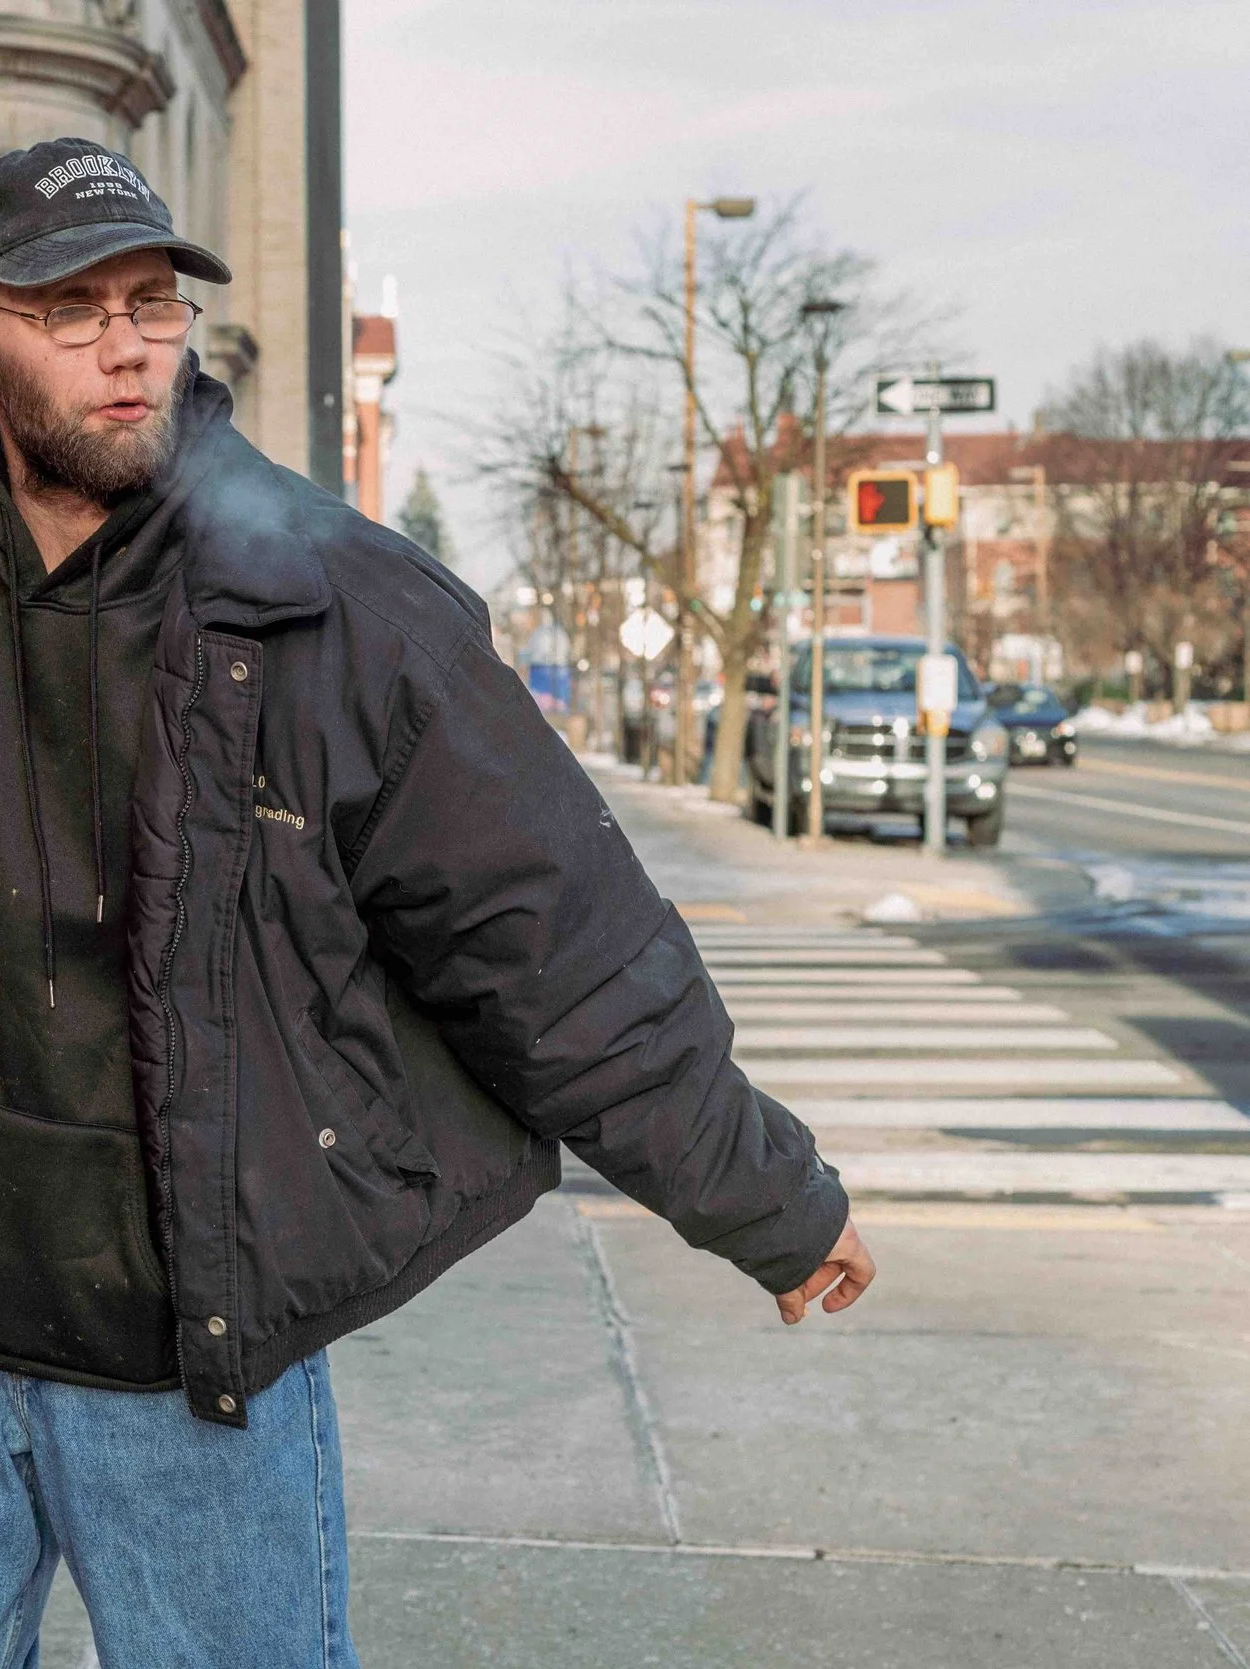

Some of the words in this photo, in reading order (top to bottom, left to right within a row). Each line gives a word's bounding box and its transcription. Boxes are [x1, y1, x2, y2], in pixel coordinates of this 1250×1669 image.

[35, 154, 150, 202] BROOKLYN
[75, 188, 105, 199] NEW
[107, 188, 138, 200] YORK
[255, 804, 305, 830] grading
